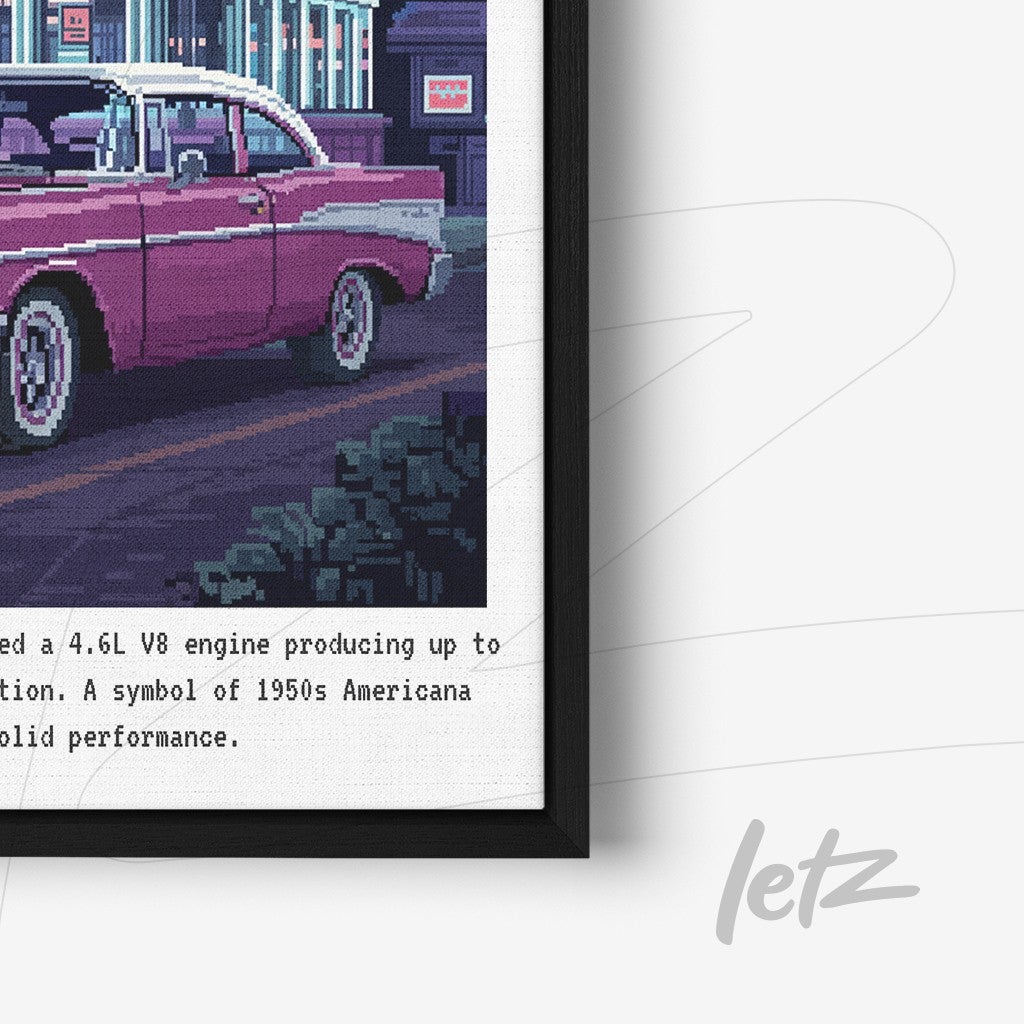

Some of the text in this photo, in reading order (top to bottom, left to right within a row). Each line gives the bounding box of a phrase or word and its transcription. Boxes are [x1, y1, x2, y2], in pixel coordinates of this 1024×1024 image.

[40, 638, 54, 655] a
[68, 632, 126, 655] 4.6L
[141, 632, 168, 655] V8
[184, 632, 270, 661] engine
[285, 632, 414, 661] producing
[429, 638, 457, 661] up
[472, 632, 501, 655] to
[83, 678, 97, 701] A
[113, 678, 197, 707] symbol
[213, 678, 240, 701] of
[258, 678, 327, 701] 1950s
[343, 678, 472, 701] Americana
[69, 724, 239, 754] performance.
